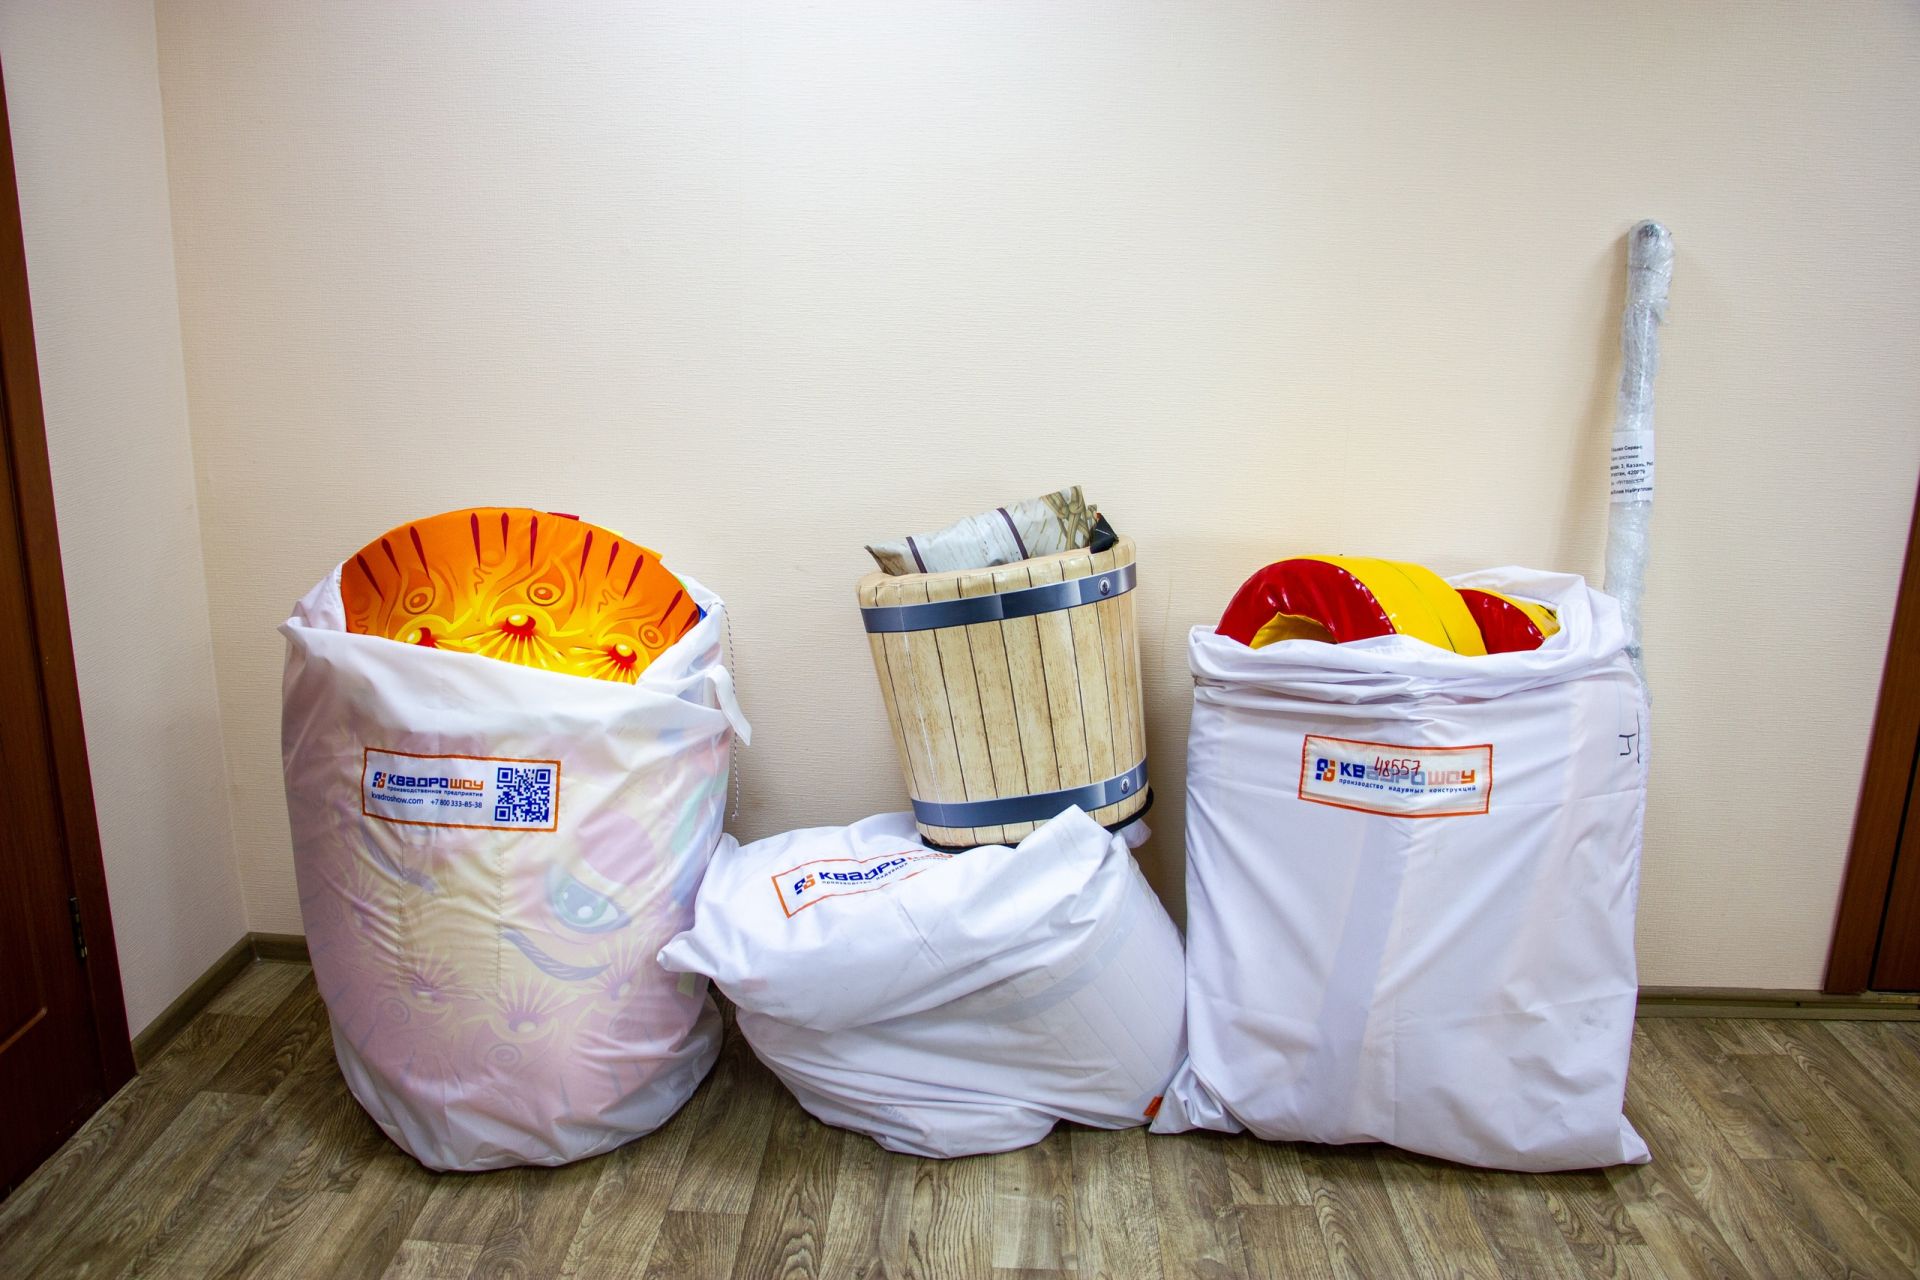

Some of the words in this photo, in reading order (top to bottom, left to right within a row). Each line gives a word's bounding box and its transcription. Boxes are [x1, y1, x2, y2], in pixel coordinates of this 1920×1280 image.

[1374, 756, 1422, 777] 48557
[387, 786, 442, 794] производственное
[444, 789, 483, 797] предприятие
[1339, 778, 1384, 790] производство
[1388, 785, 1424, 794] надувных
[1428, 785, 1476, 794] конструкций
[371, 792, 424, 805] kvadroshow.com
